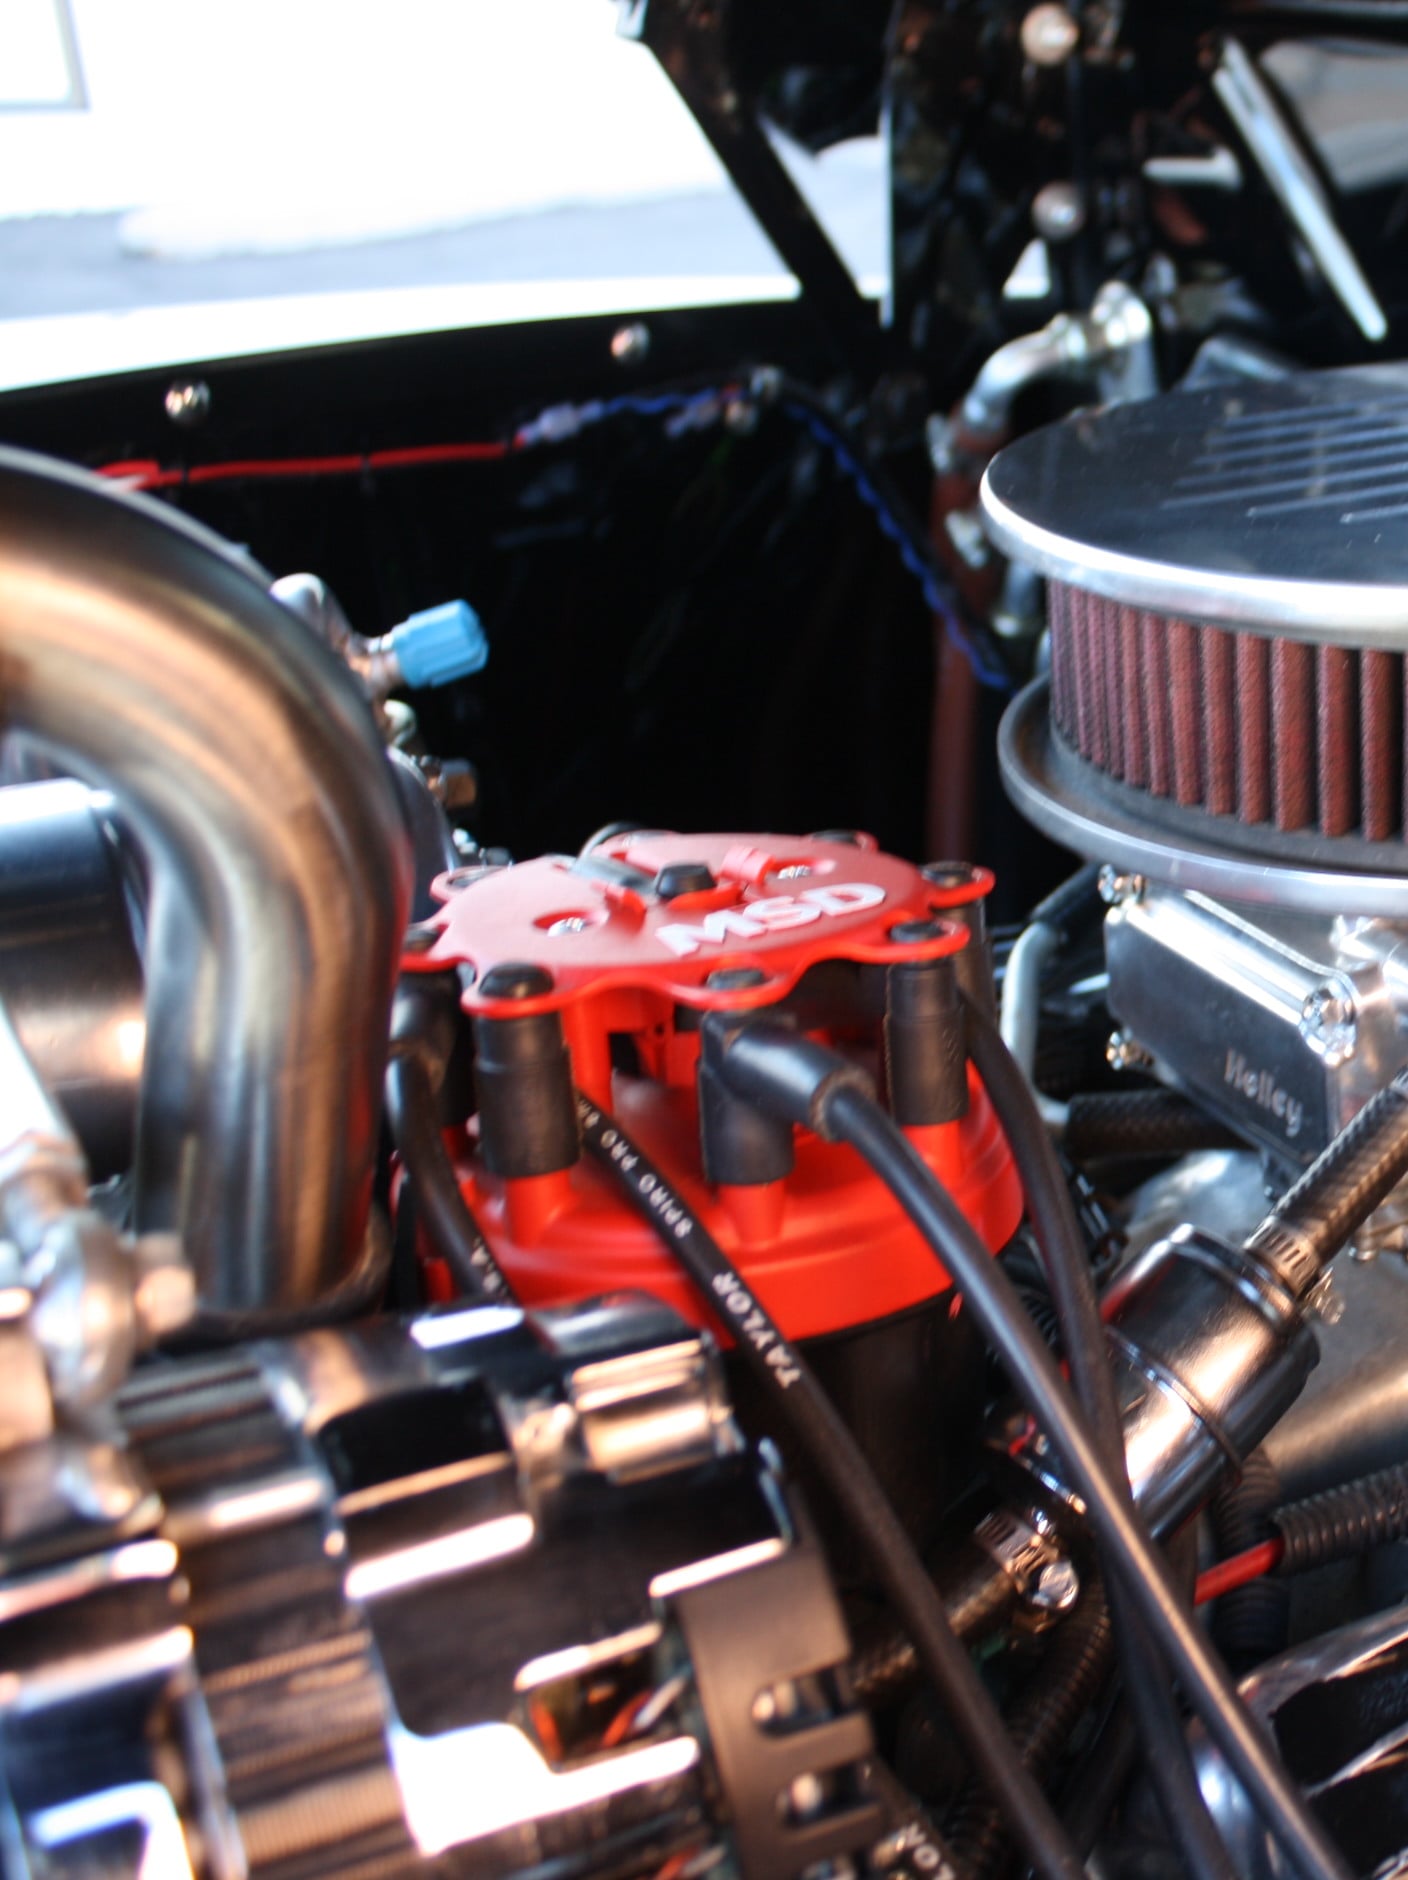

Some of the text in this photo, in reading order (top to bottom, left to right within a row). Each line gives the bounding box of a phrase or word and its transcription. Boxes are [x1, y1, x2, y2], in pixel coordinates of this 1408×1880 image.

[654, 882, 887, 957] MSD
[1224, 1049, 1303, 1138] Holley
[601, 1129, 640, 1172] PRO
[639, 1173, 693, 1239] SPIRO
[712, 1272, 801, 1389] TAYLOR
